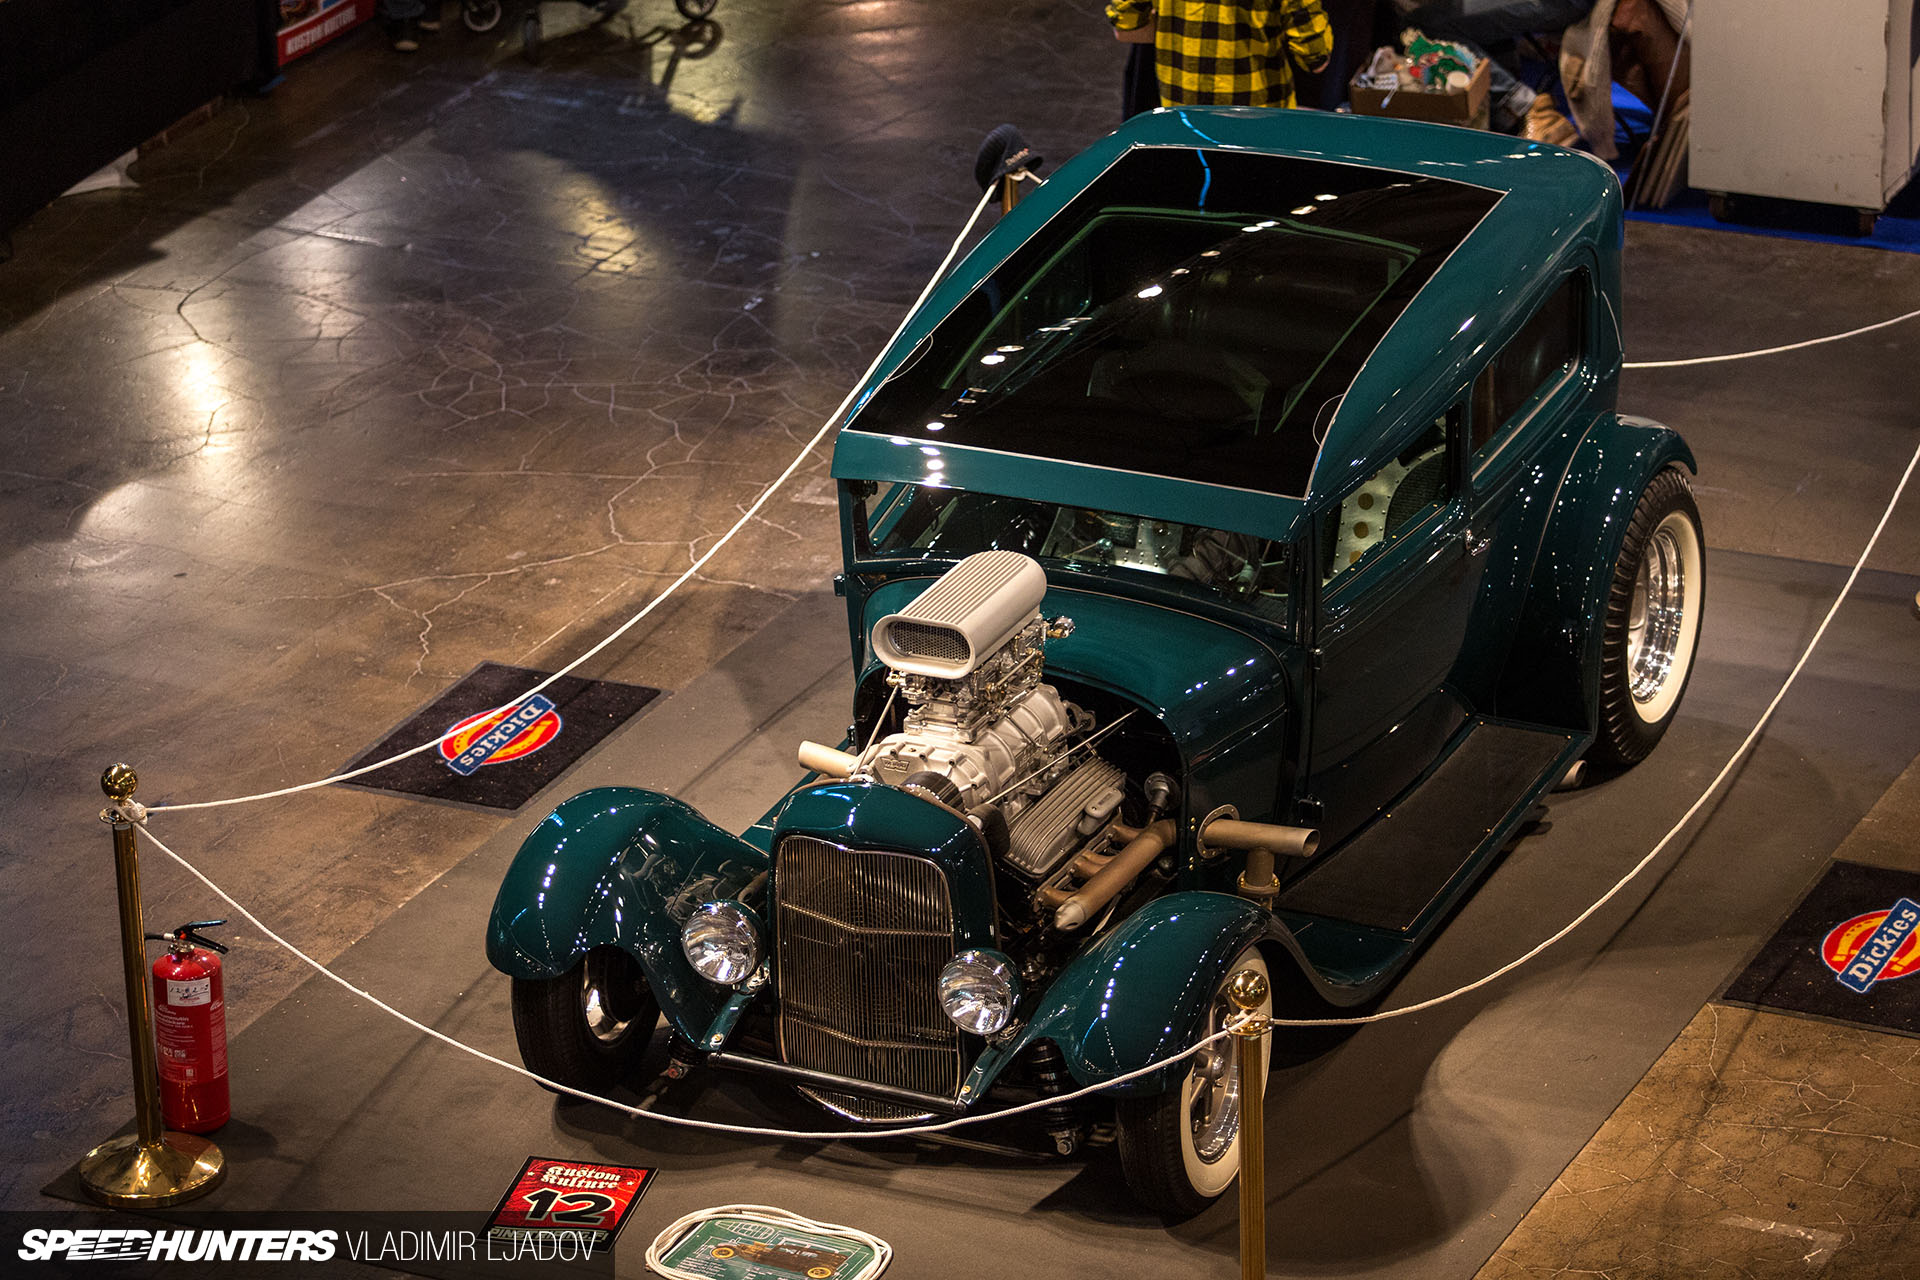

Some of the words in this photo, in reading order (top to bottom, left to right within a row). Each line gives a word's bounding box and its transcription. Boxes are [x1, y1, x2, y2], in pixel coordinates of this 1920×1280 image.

[460, 703, 543, 766] Dickies
[1848, 909, 1918, 982] Dickies
[540, 1174, 619, 1189] Kulture
[546, 1166, 621, 1182] Kustom
[522, 1187, 616, 1225] 12
